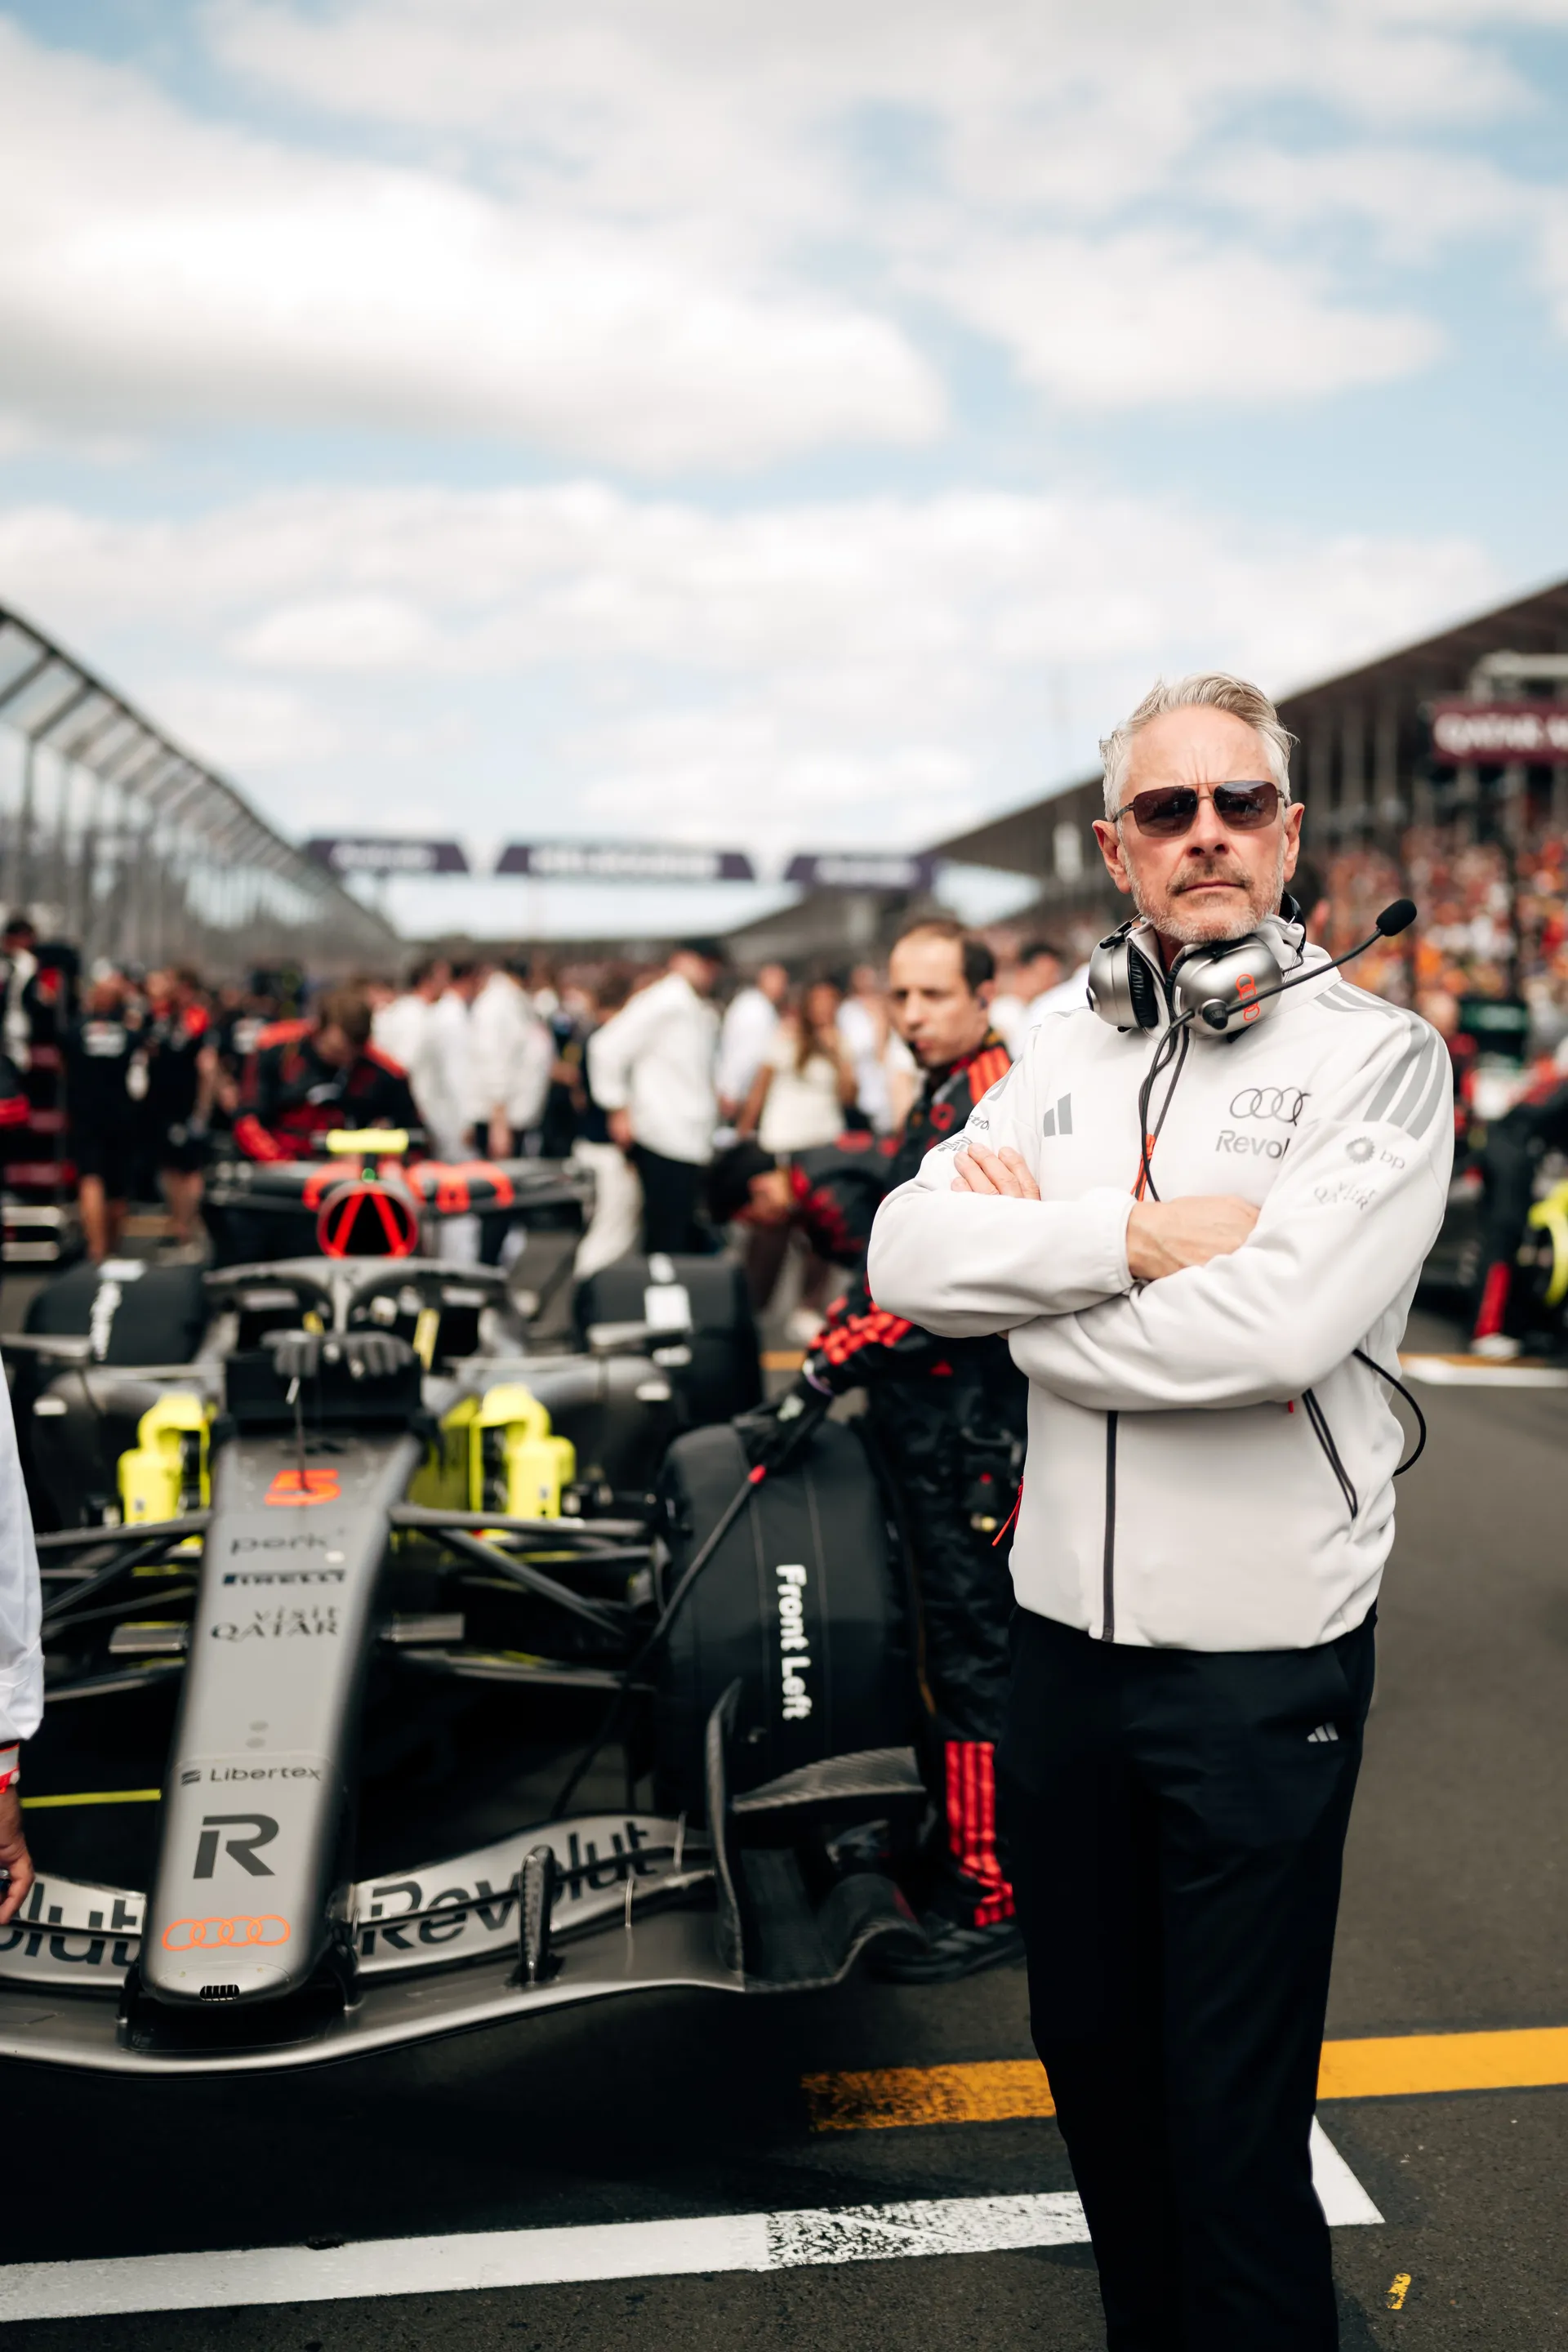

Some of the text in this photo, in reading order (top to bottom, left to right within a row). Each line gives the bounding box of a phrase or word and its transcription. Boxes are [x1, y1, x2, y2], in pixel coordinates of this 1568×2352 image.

[1379, 1150, 1405, 1169] bp
[264, 1468, 342, 1506] 5
[211, 1620, 339, 1642] QATAR
[776, 1564, 812, 1720] Front Left
[210, 1766, 321, 1783] Libertex
[360, 1820, 657, 1955] Revlut
